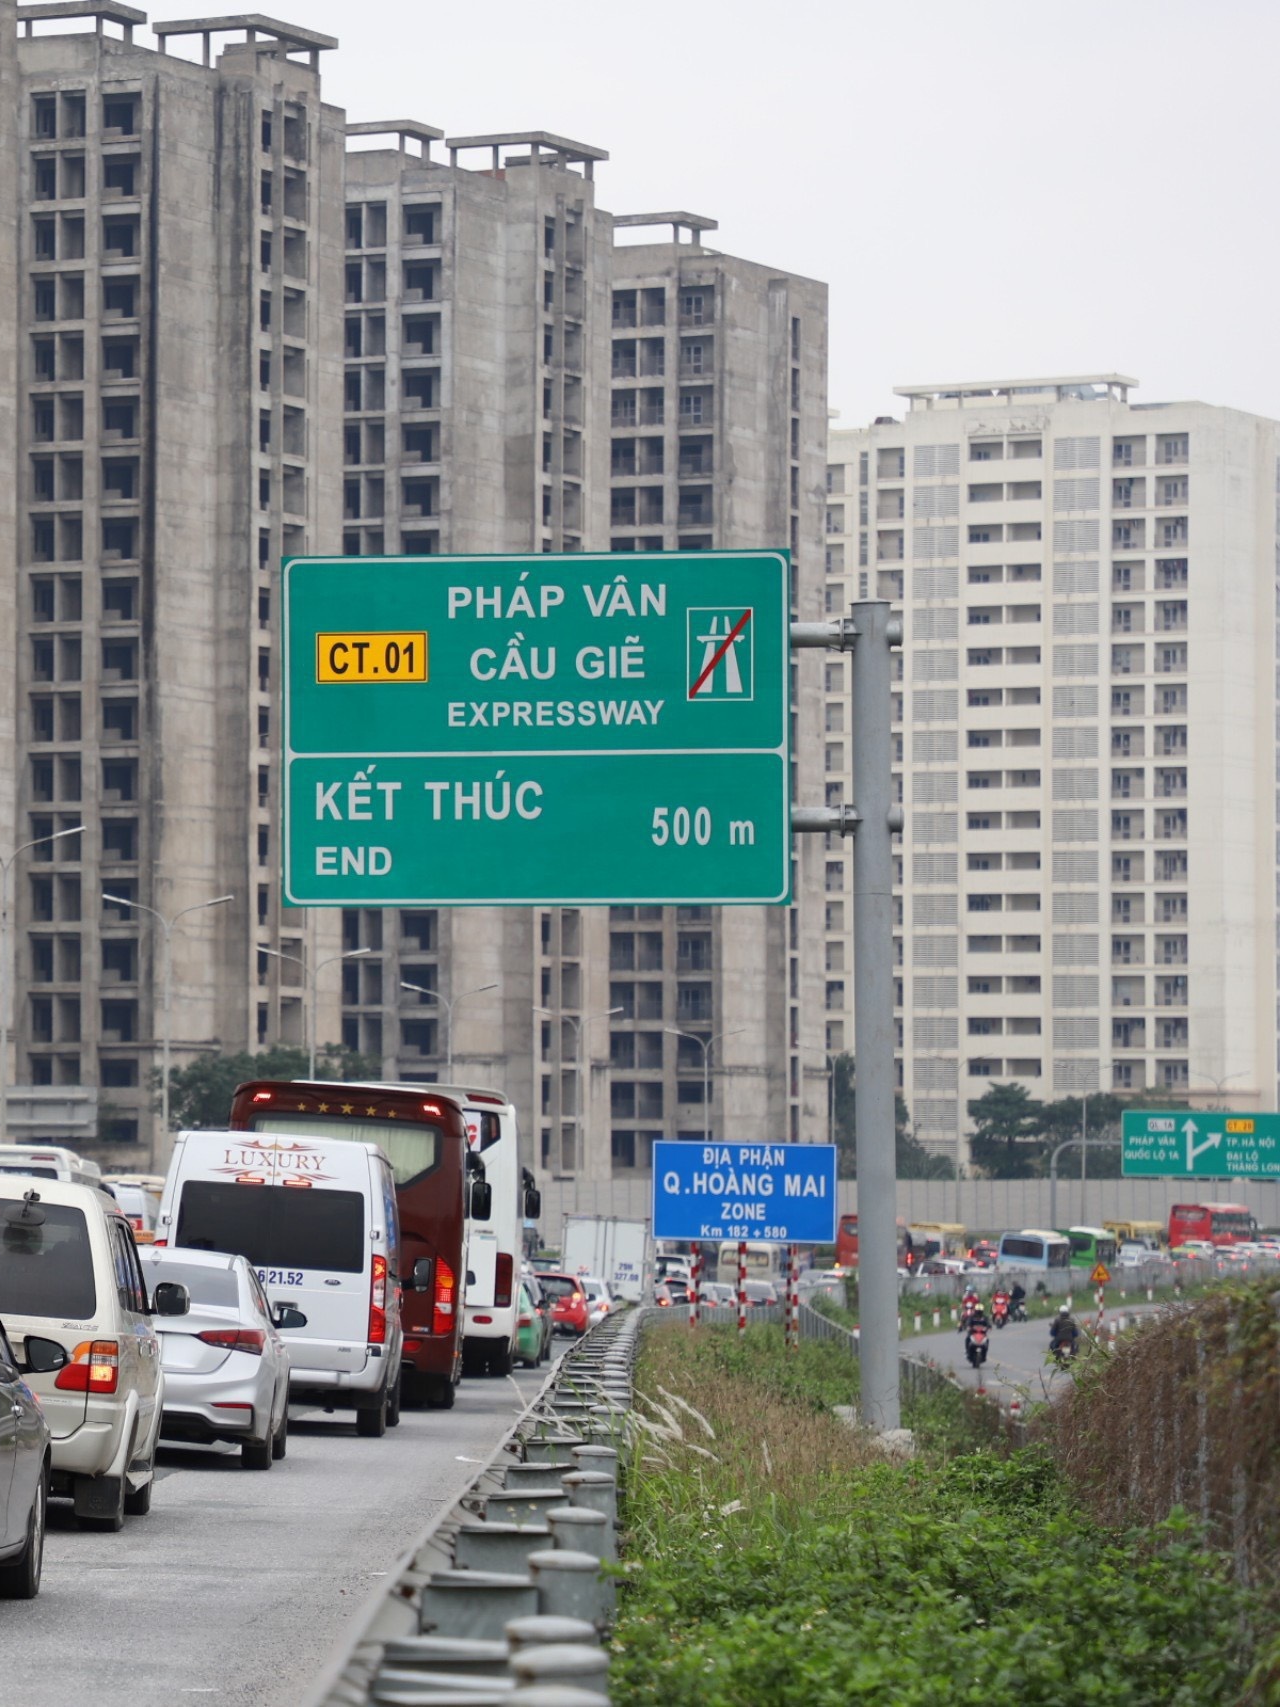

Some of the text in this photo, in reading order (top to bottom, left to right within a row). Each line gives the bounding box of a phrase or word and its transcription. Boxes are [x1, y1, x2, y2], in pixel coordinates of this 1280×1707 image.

[447, 571, 666, 619] PHÁP VÂN
[328, 641, 416, 675] CT.01
[470, 631, 645, 681] CẦU GIẼ
[447, 699, 665, 727] EXPRESSWAY
[316, 764, 543, 821] KẾT THÚC
[651, 807, 755, 846] 500 m
[315, 846, 393, 876] END
[1129, 1134, 1176, 1146] PHÁP VÂN
[224, 1149, 327, 1171] LUXURY
[703, 1145, 785, 1170] ĐỊA PHẬN
[1169, 1150, 1180, 1160] 1A
[784, 1174, 826, 1198] MAI
[721, 1202, 767, 1221] ZONE
[700, 1224, 723, 1237] Km
[727, 1225, 749, 1238] 182
[764, 1225, 787, 1239] 580
